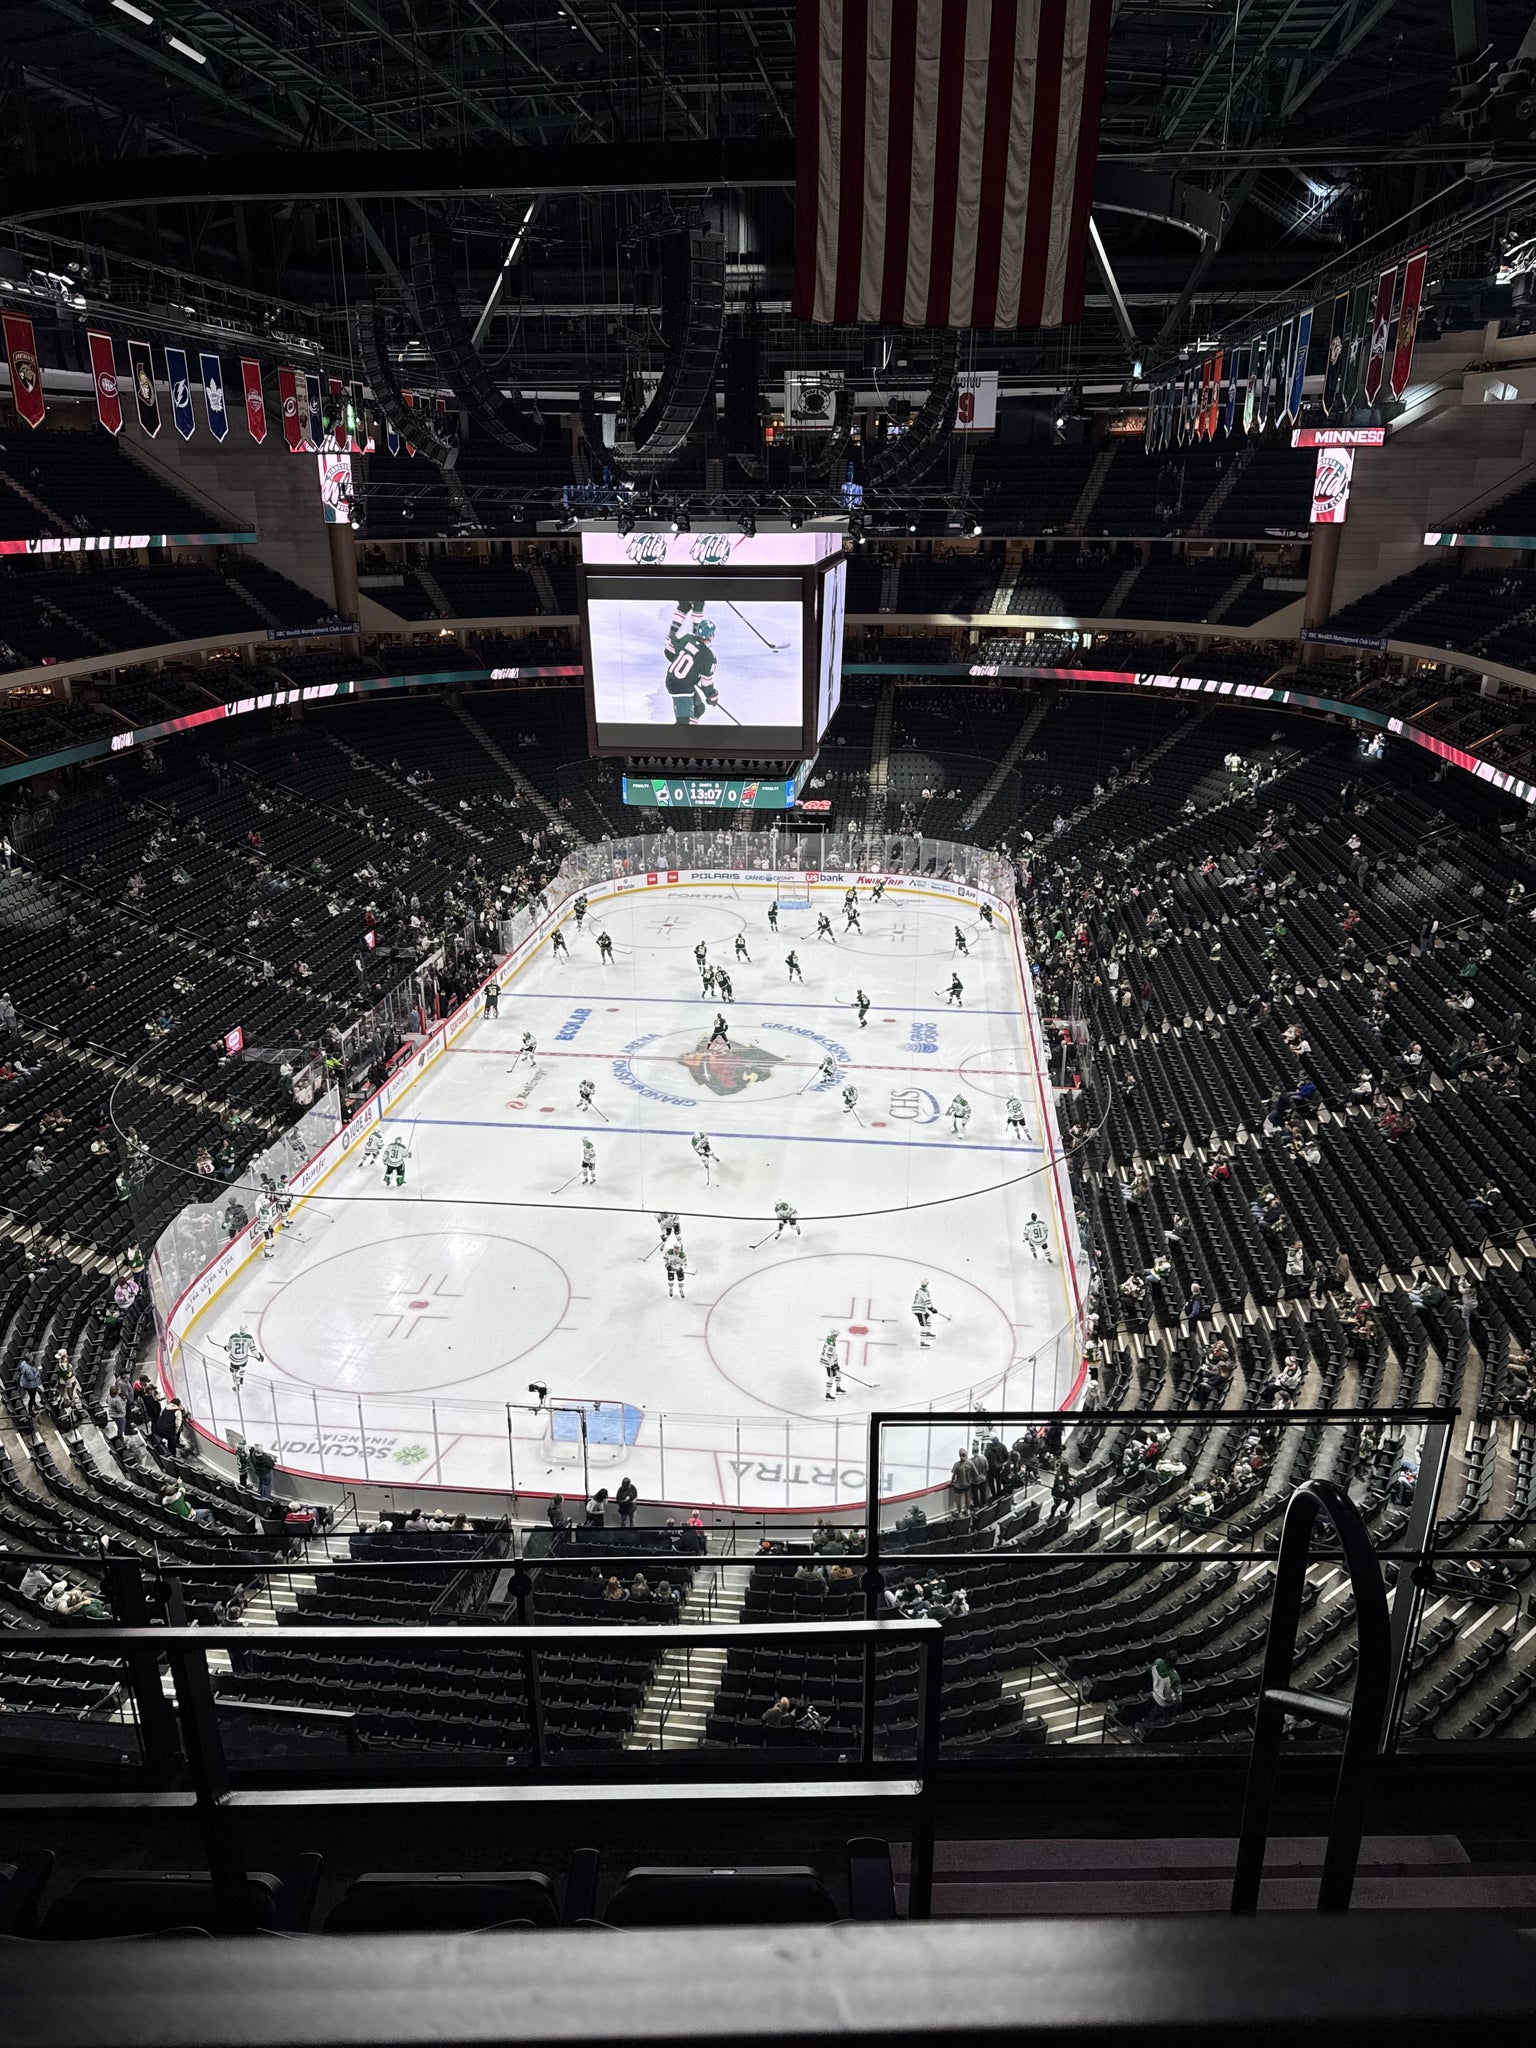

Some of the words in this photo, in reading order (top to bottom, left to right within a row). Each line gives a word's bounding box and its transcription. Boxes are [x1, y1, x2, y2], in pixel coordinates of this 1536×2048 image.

[959, 392, 975, 423] 9
[674, 788, 684, 800] 0
[690, 788, 722, 800] 13:07
[728, 790, 737, 801] 0
[820, 873, 844, 882] bank
[883, 877, 904, 886] TRIP
[554, 1008, 592, 1040] ECOLAB
[761, 1022, 815, 1036] GRAND
[612, 1059, 636, 1086] CASINO
[638, 1089, 697, 1107] GRAND
[889, 1090, 920, 1119] CHS
[391, 1149, 399, 1159] 31
[1033, 1228, 1042, 1239] 91
[200, 1274, 217, 1292] ULTRA
[217, 1256, 234, 1273] ULTRA
[234, 1342, 245, 1354] 21
[729, 1460, 894, 1491] FORTRA
